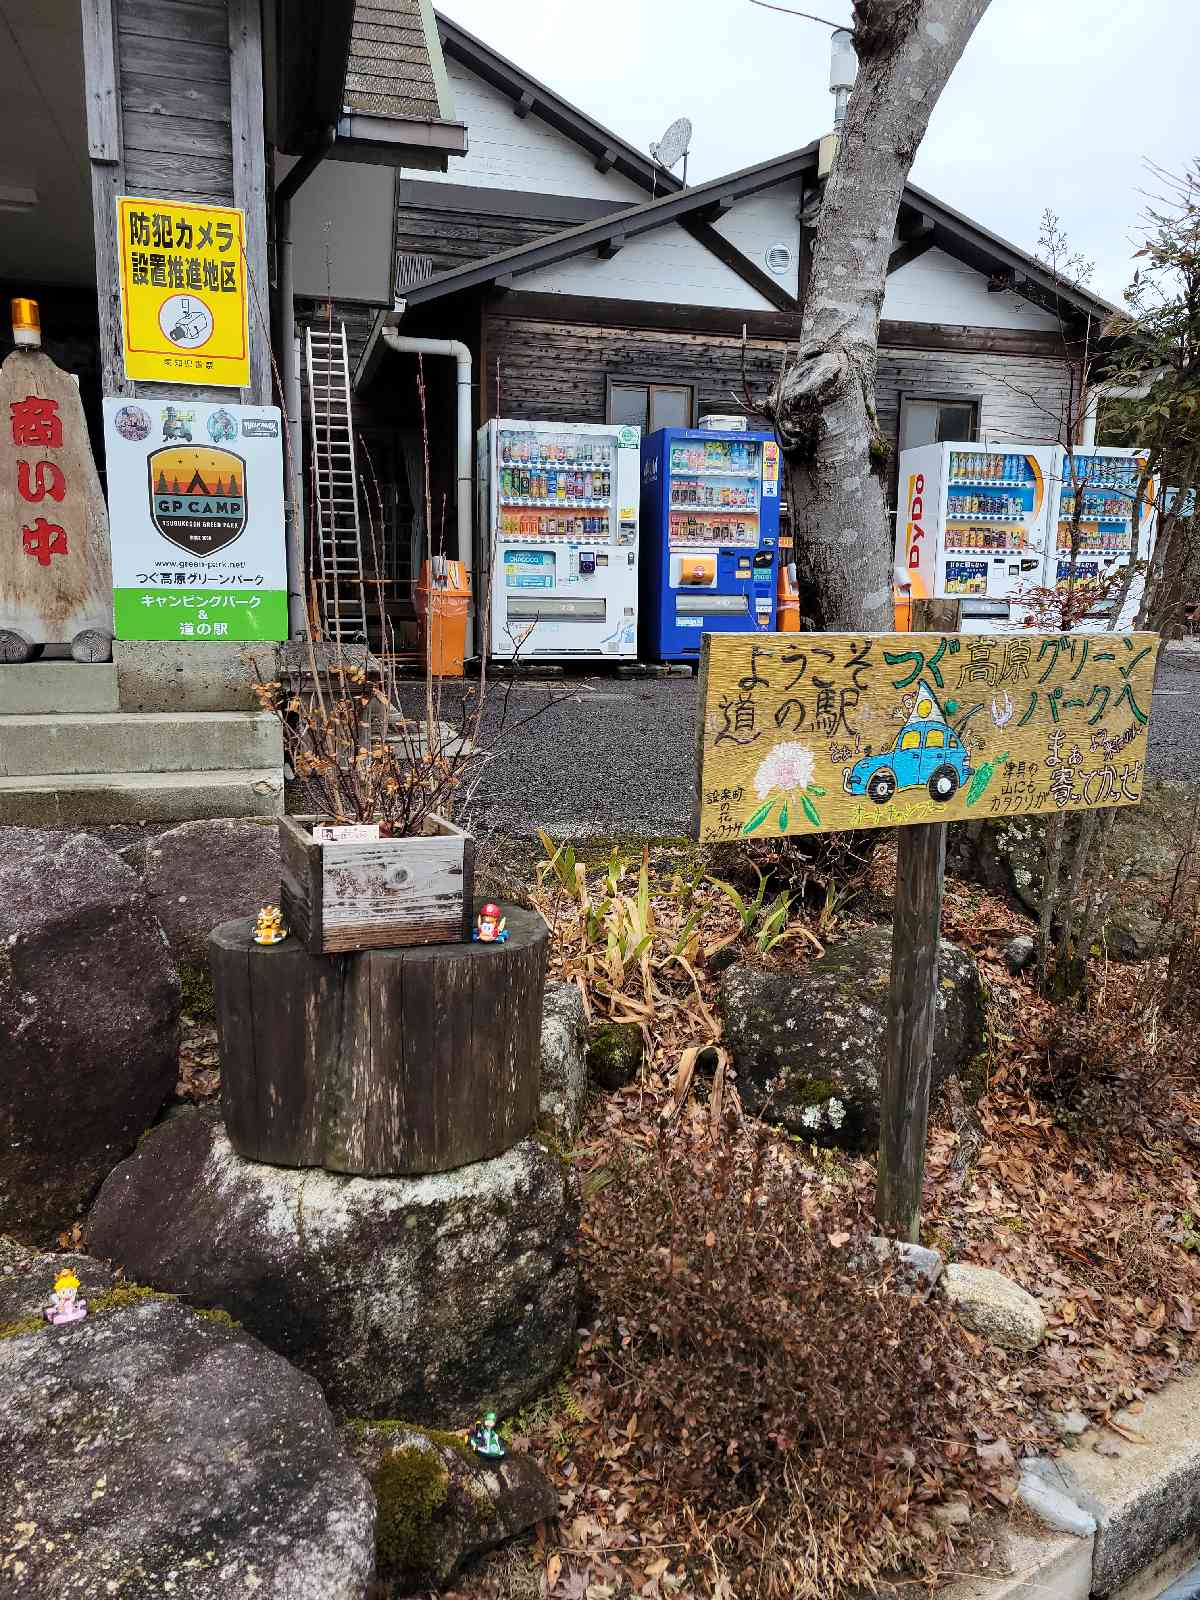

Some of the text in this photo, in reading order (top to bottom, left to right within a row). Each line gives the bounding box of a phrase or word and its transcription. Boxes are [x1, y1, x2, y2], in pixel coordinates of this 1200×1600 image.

[129, 211, 233, 252] 防犯カメラ
[131, 252, 237, 292] 設置推進地区
[10, 396, 68, 566] 商い中
[159, 500, 241, 514] GP CAMP
[135, 572, 264, 586] つぐ高原グリーンパーク
[141, 594, 262, 608] キャンピングパーク
[198, 610, 208, 620] &
[180, 623, 229, 636] 道の駅
[738, 640, 873, 691] ようこそ
[714, 687, 860, 745] 道の駅
